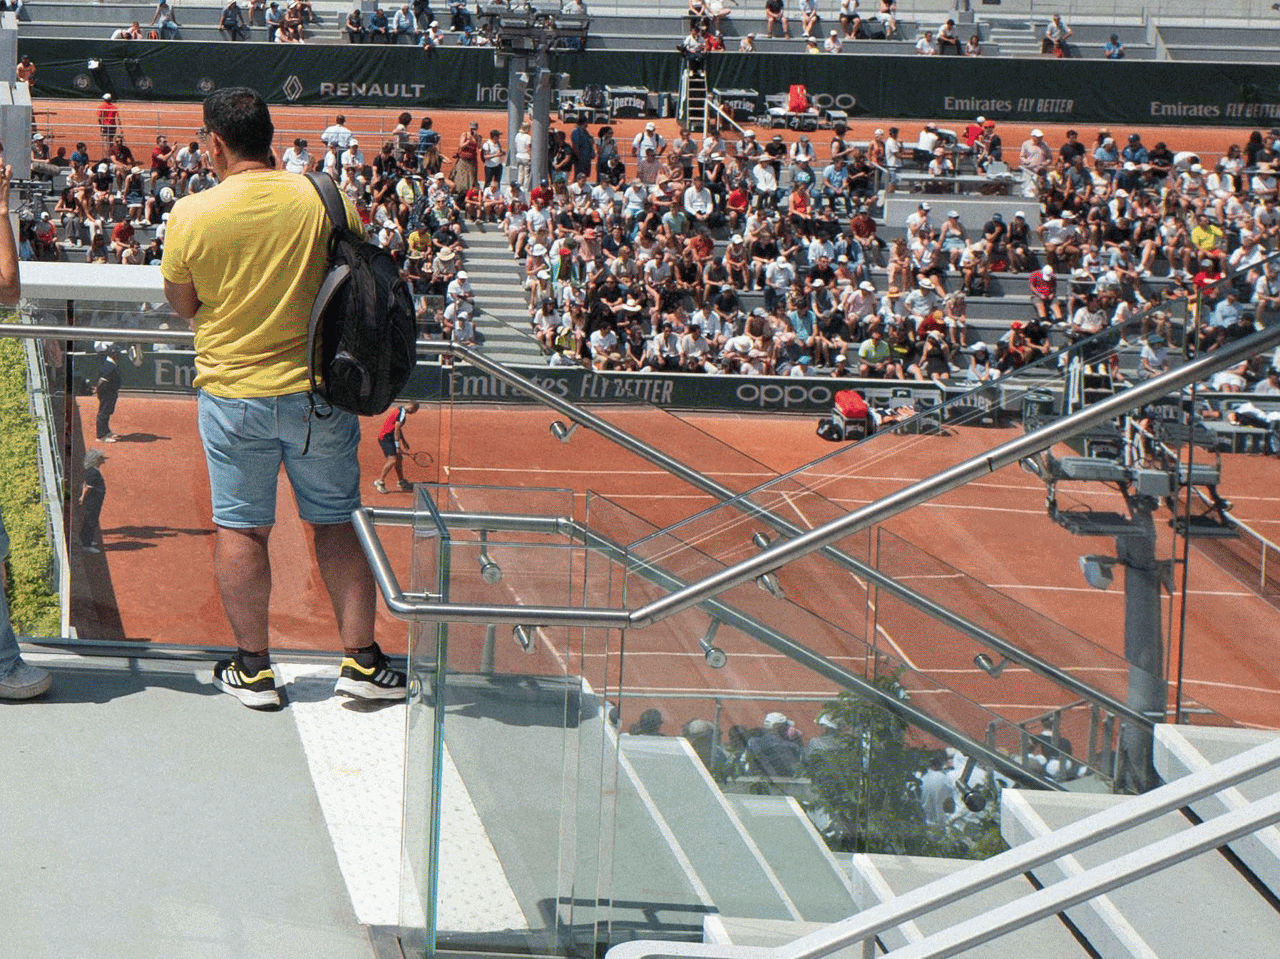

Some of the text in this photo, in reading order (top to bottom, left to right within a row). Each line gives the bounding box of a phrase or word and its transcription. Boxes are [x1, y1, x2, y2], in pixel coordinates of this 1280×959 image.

[320, 82, 425, 98] RENAULT
[944, 96, 1074, 114] Emirates FLY BETTER
[1150, 101, 1220, 117] Emirates
[735, 383, 831, 408] oppo
